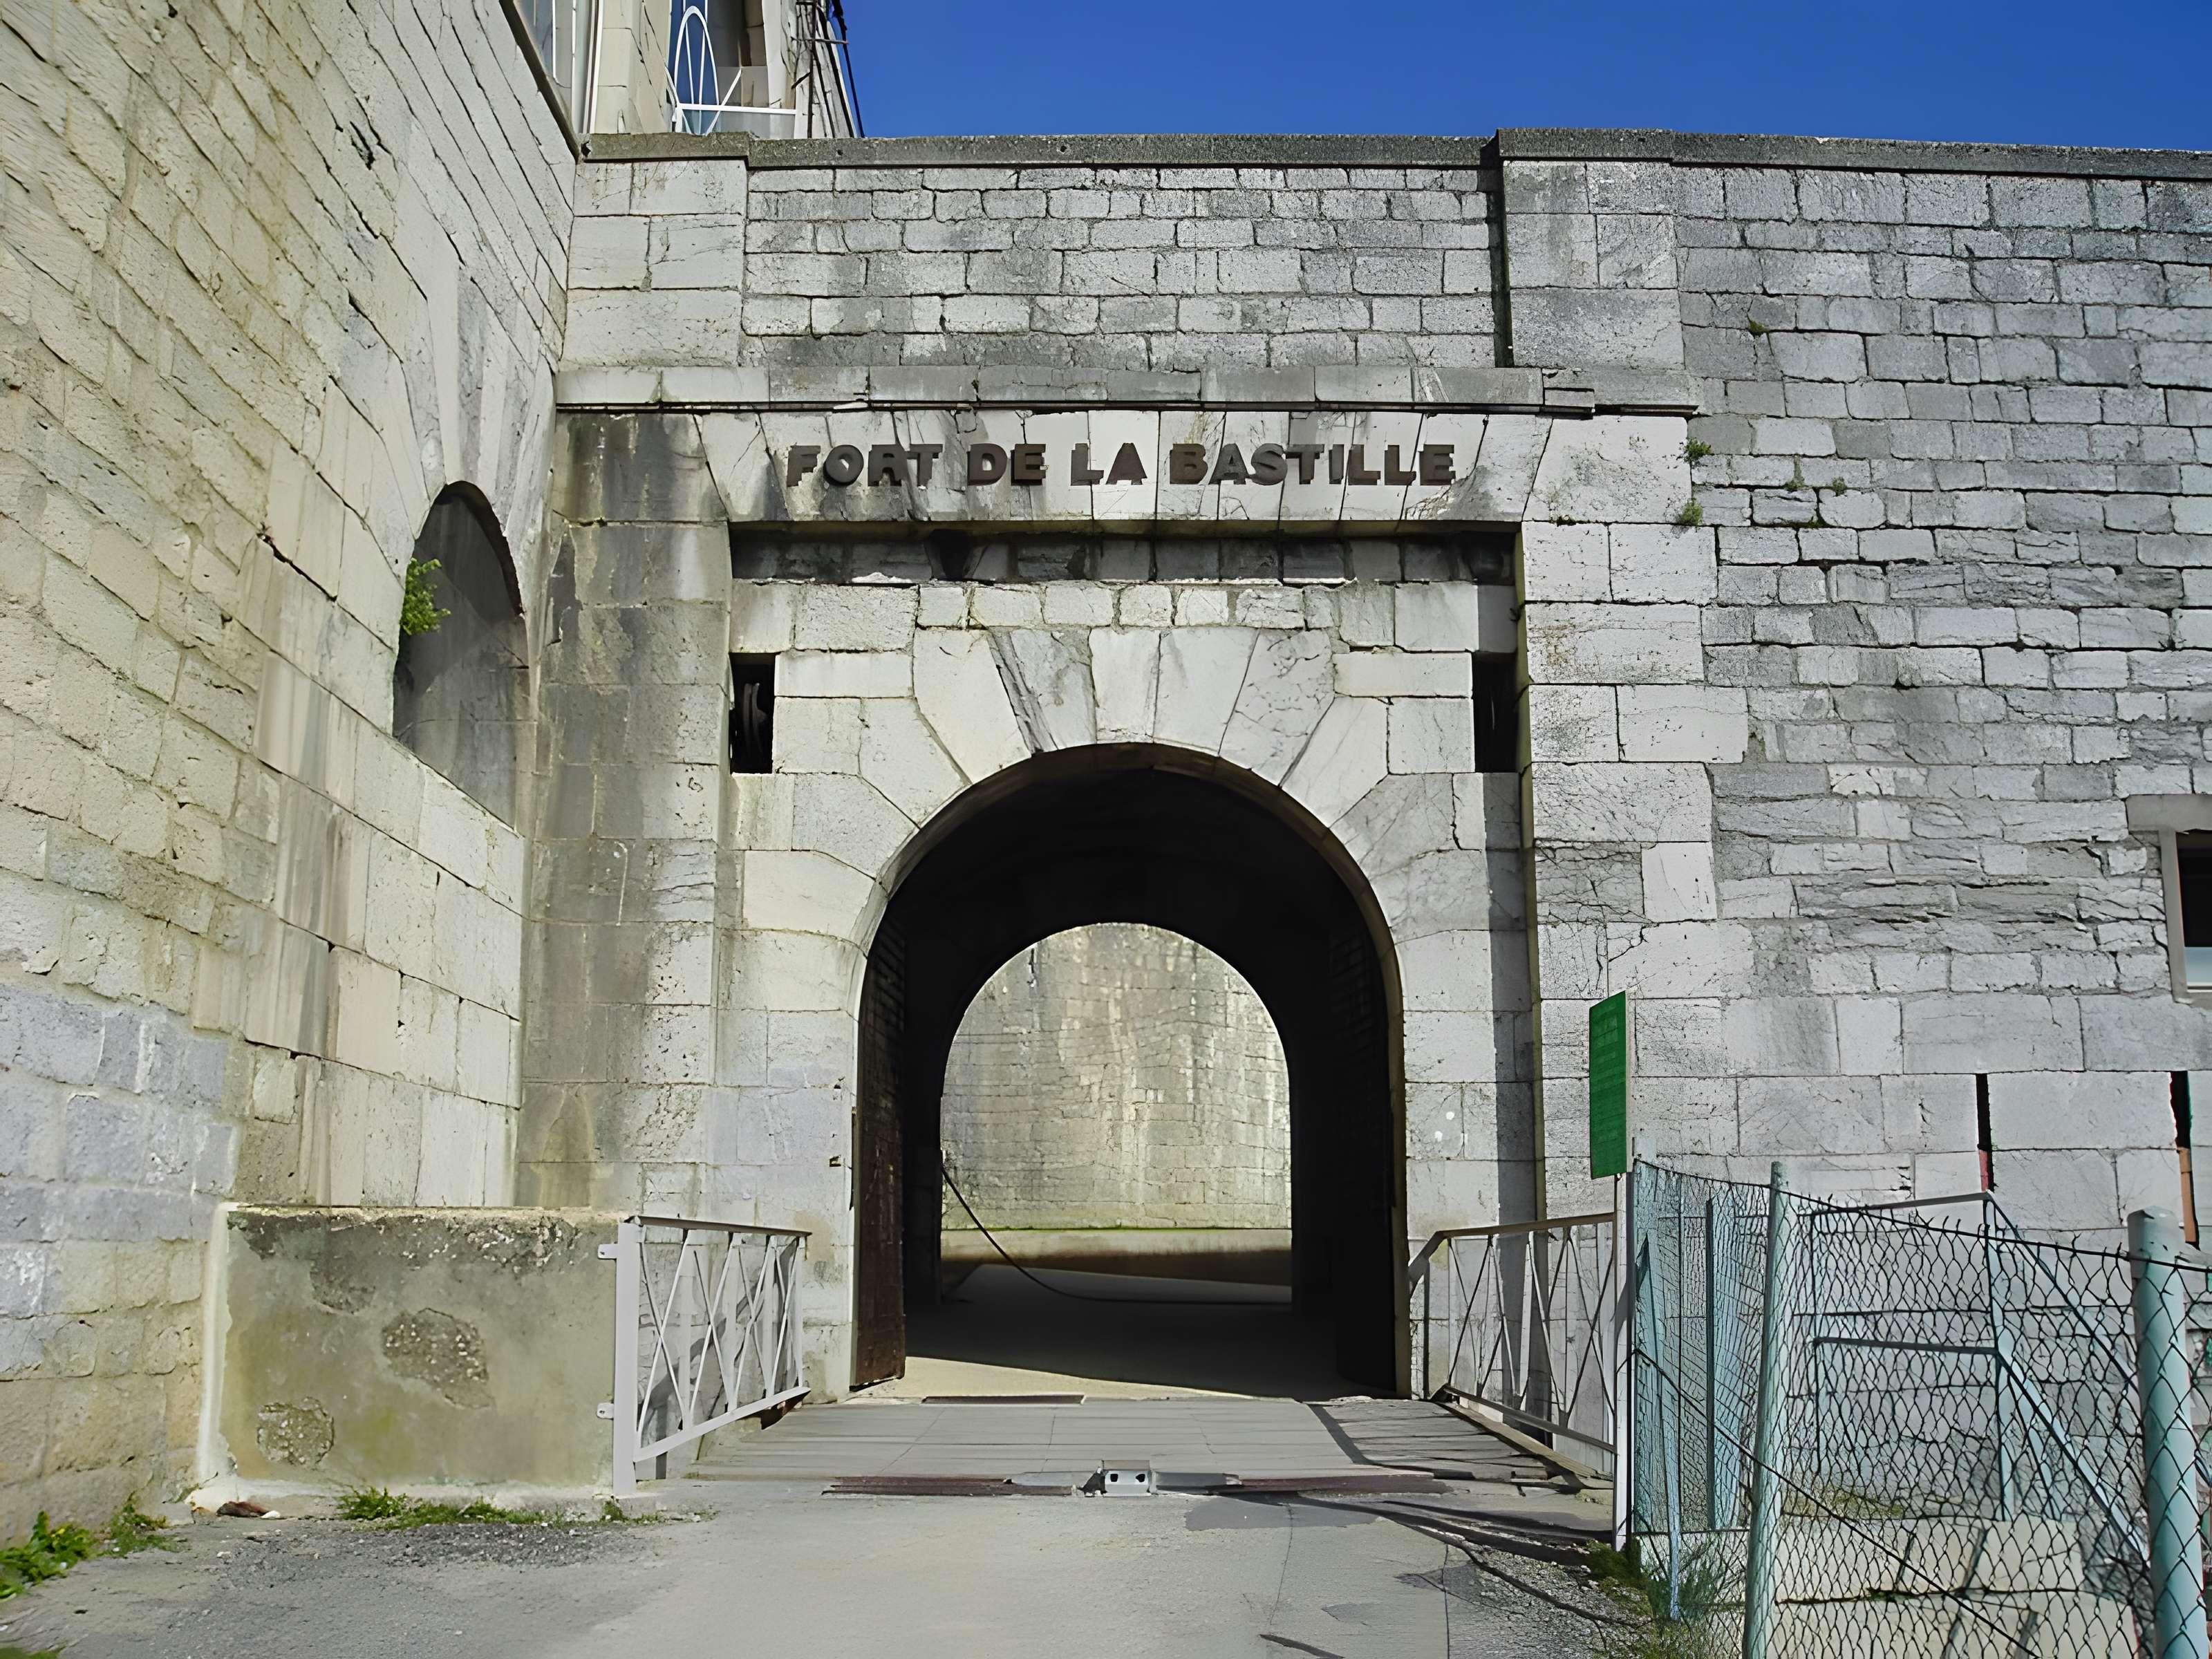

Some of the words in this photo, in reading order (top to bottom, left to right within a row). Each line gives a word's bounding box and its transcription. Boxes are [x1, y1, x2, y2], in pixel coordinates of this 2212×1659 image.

[787, 444, 943, 487] FORT
[967, 443, 1046, 486] DE
[1071, 442, 1147, 486] LA
[1170, 443, 1456, 486] BASTILLE
